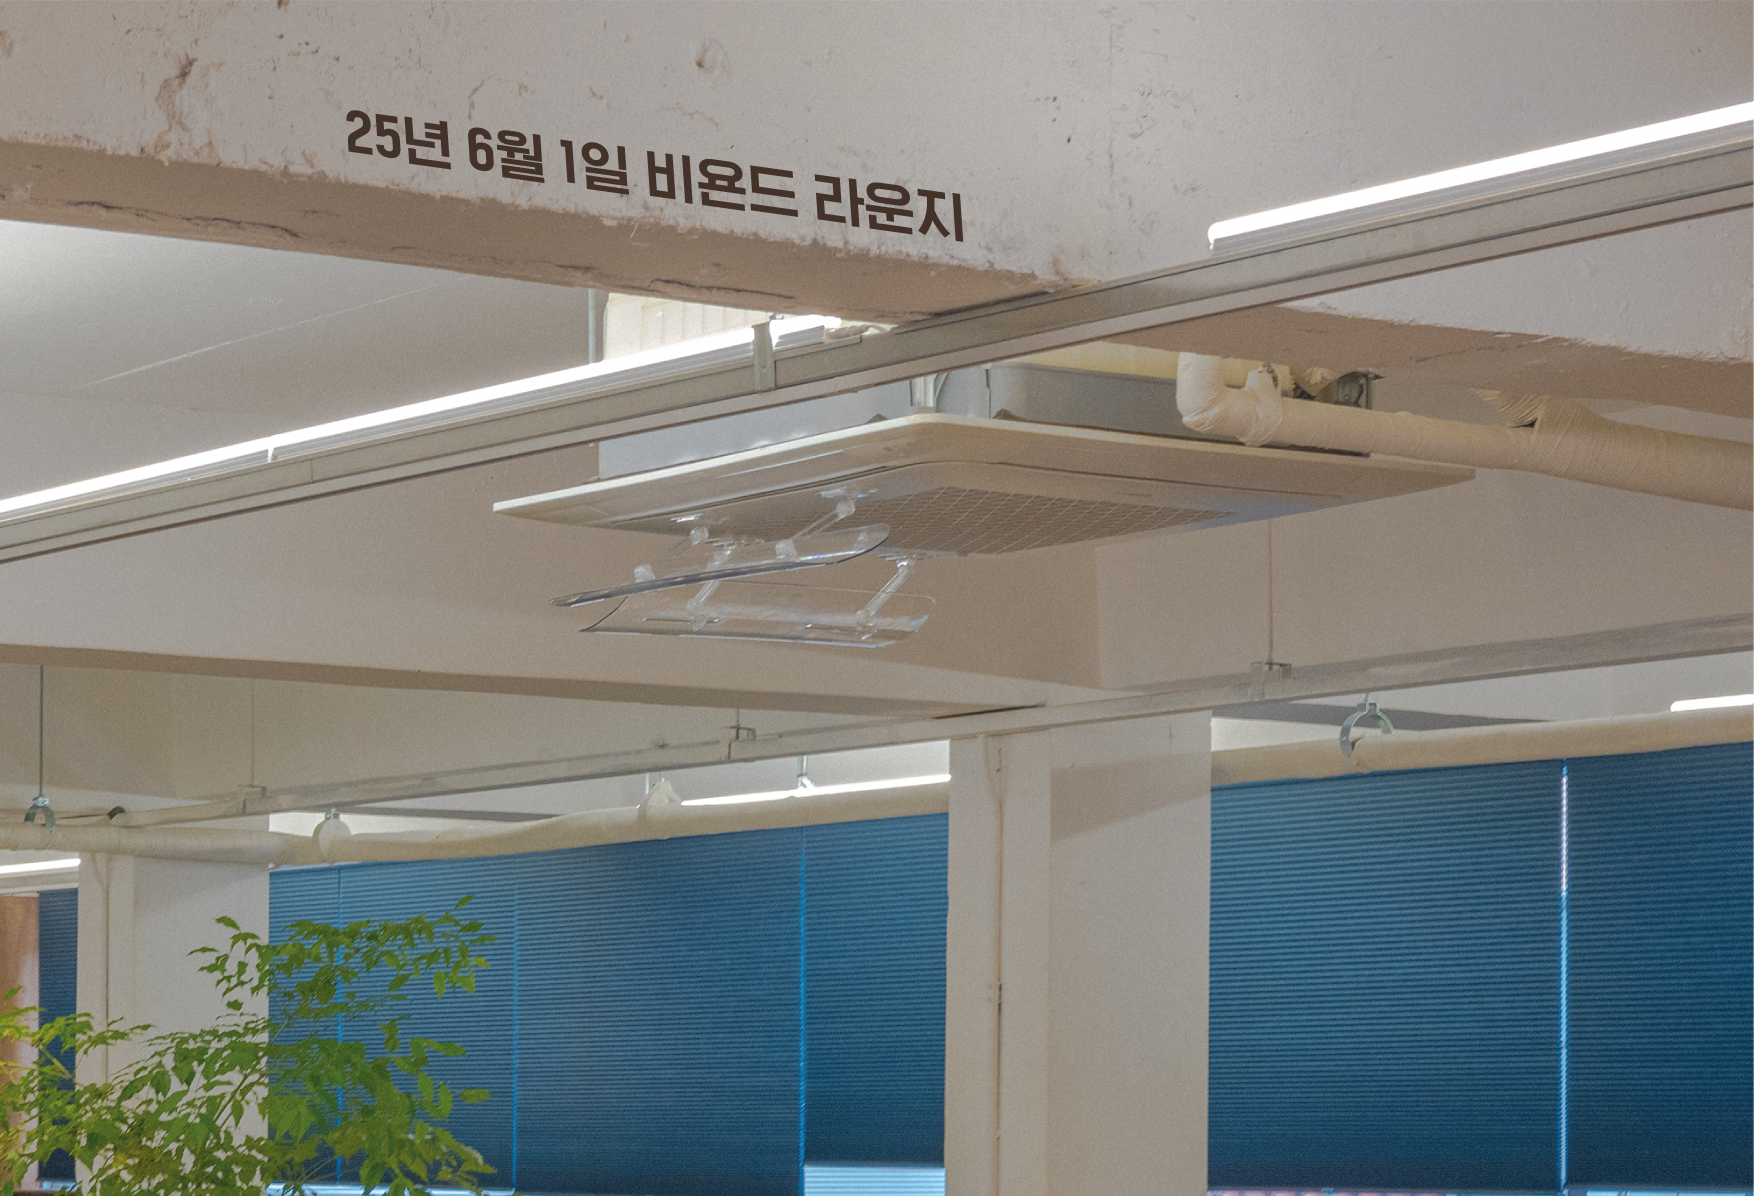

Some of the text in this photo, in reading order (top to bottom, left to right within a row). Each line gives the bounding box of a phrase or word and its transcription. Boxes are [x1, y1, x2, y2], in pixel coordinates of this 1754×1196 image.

[345, 109, 965, 243] 25년 6월 1일 비욘드 라운지
